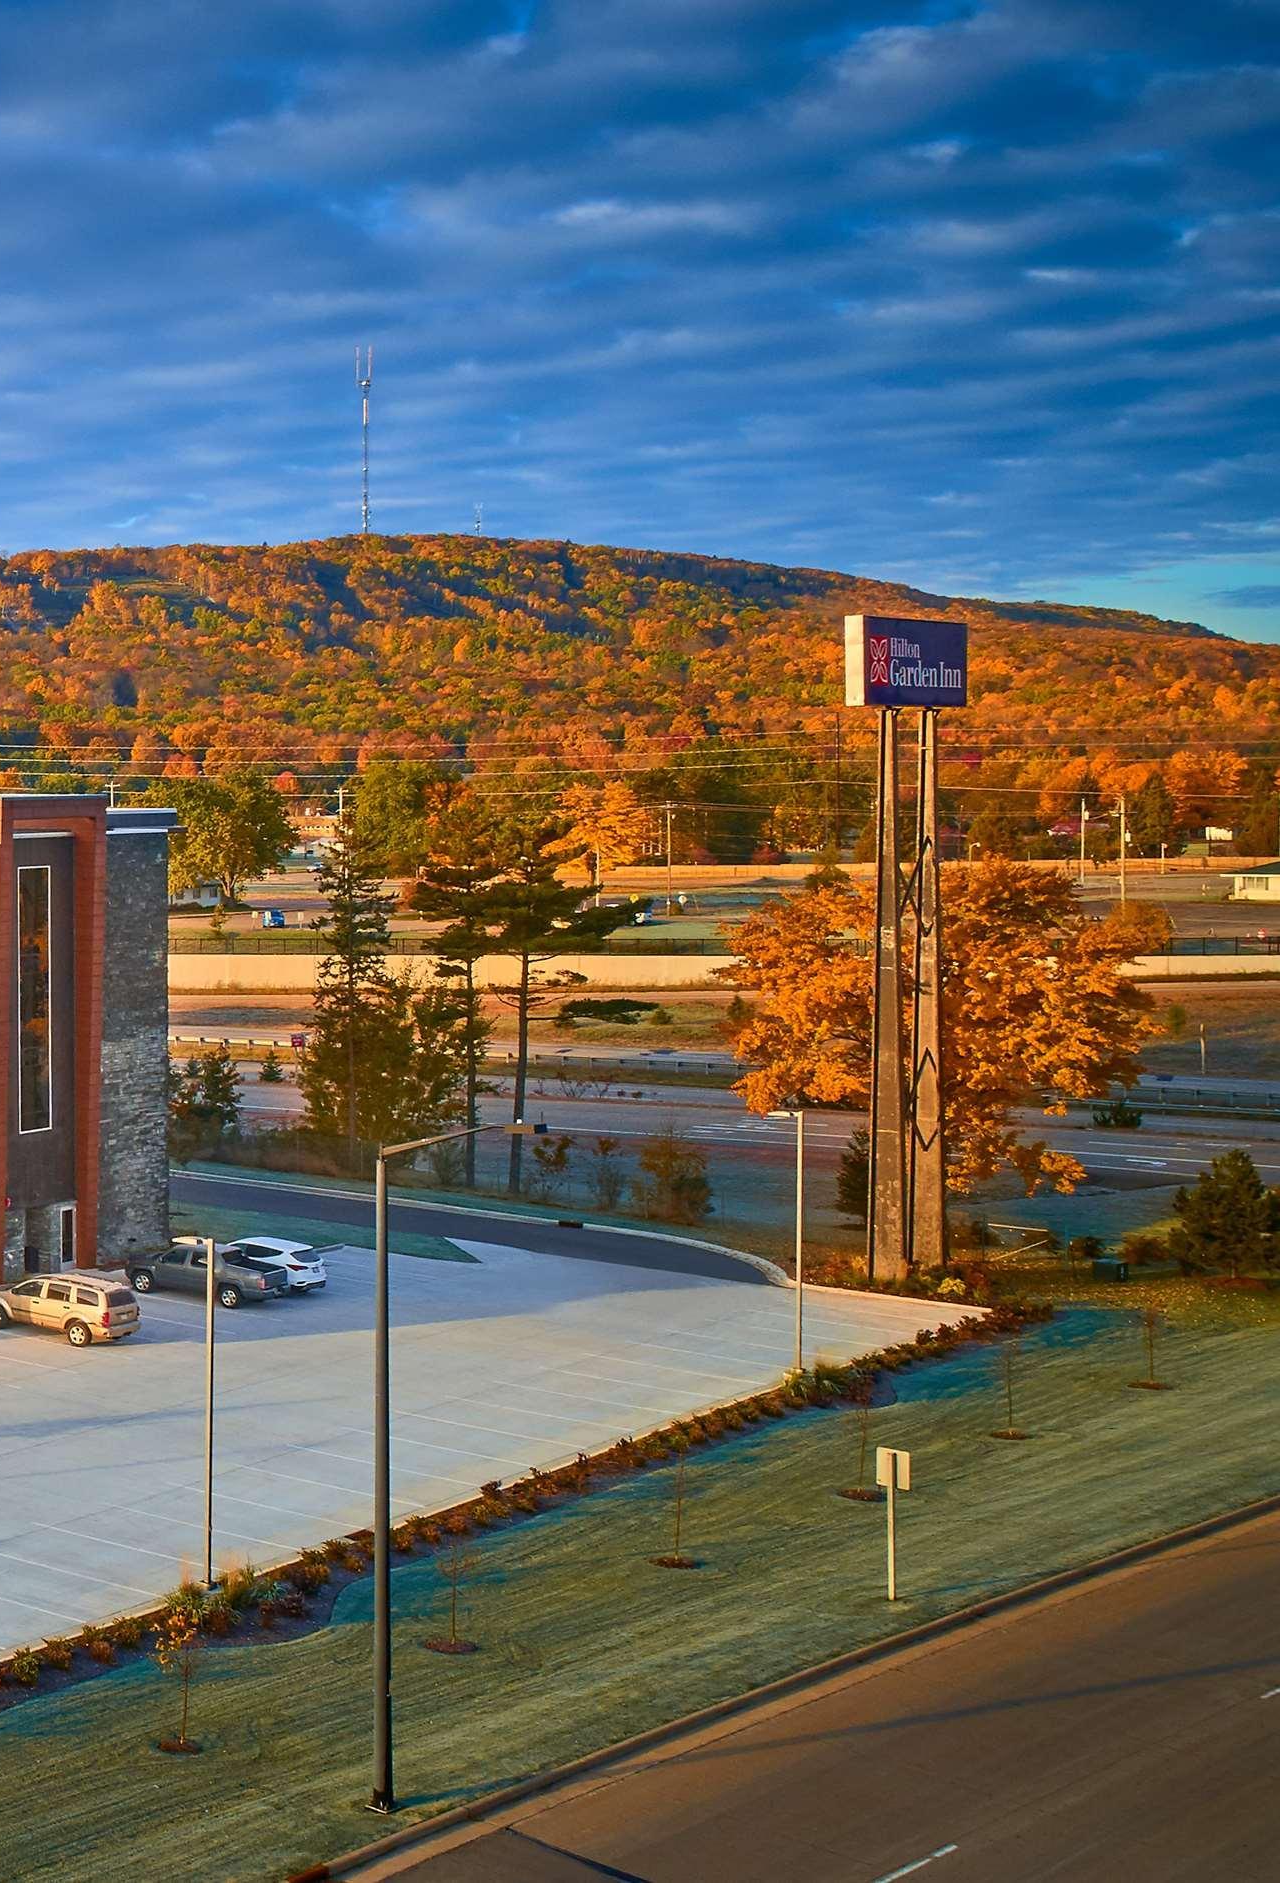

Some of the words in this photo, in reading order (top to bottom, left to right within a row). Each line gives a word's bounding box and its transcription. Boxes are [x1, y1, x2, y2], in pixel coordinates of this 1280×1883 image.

[890, 637, 920, 658] Hilton
[890, 659, 938, 687] Garden
[939, 661, 962, 688] Inn
